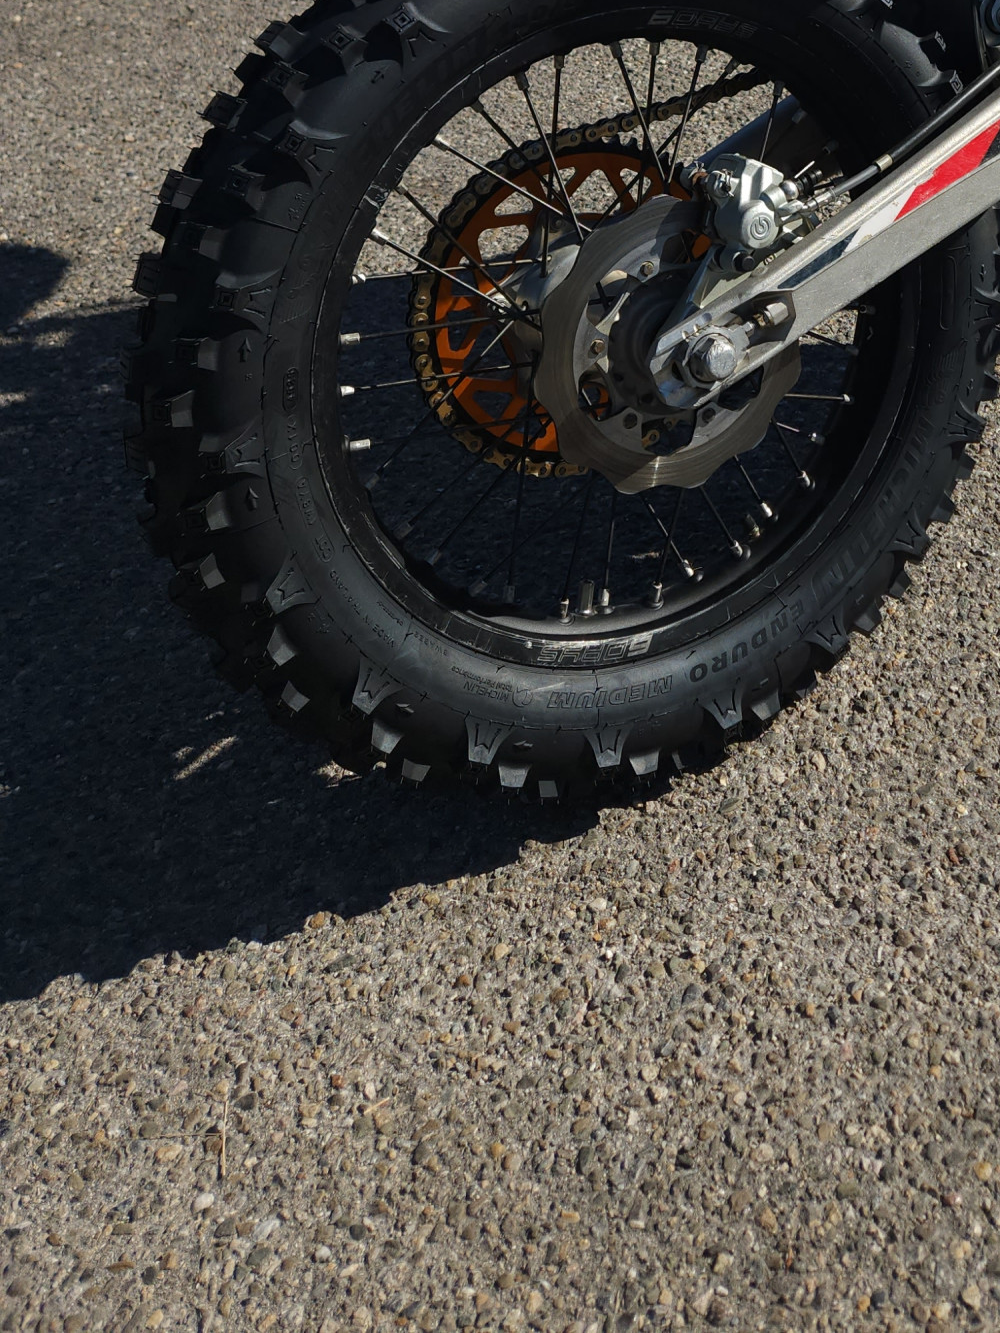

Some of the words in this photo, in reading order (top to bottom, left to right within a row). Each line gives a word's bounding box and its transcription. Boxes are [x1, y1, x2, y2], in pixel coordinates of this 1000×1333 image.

[537, 633, 654, 666] 6DAYS
[689, 600, 806, 683] ENDURO
[462, 680, 509, 702] MICHELIN
[547, 673, 673, 711] MEDIUM
